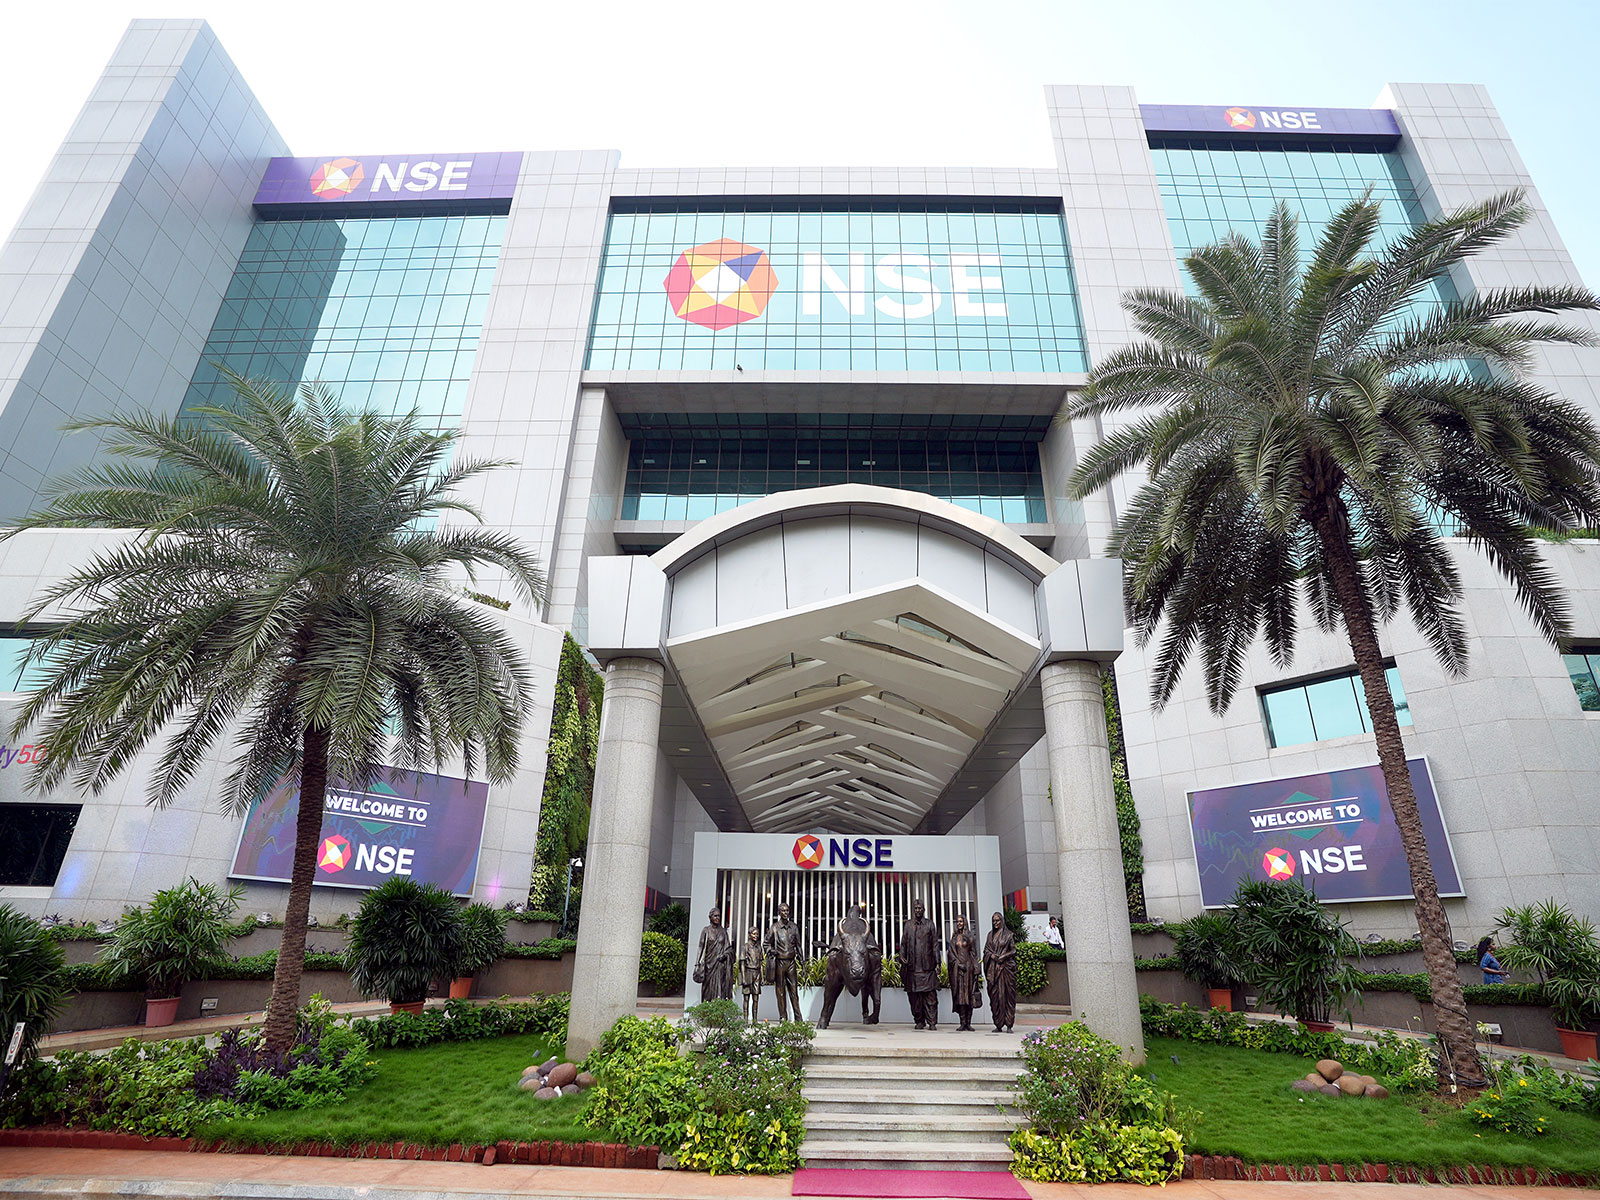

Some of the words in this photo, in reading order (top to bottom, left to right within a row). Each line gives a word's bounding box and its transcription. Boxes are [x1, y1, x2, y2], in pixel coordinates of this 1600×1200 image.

[1259, 110, 1322, 130] NSE
[370, 160, 473, 193] NSE
[802, 251, 1009, 320] NSE
[325, 794, 405, 819] WELCOME
[407, 806, 428, 822] TO
[1250, 807, 1333, 829] WELCOME
[1335, 803, 1361, 818] TO
[354, 843, 415, 876] NSE
[829, 838, 894, 868] NSE
[1300, 844, 1368, 875] NSE
